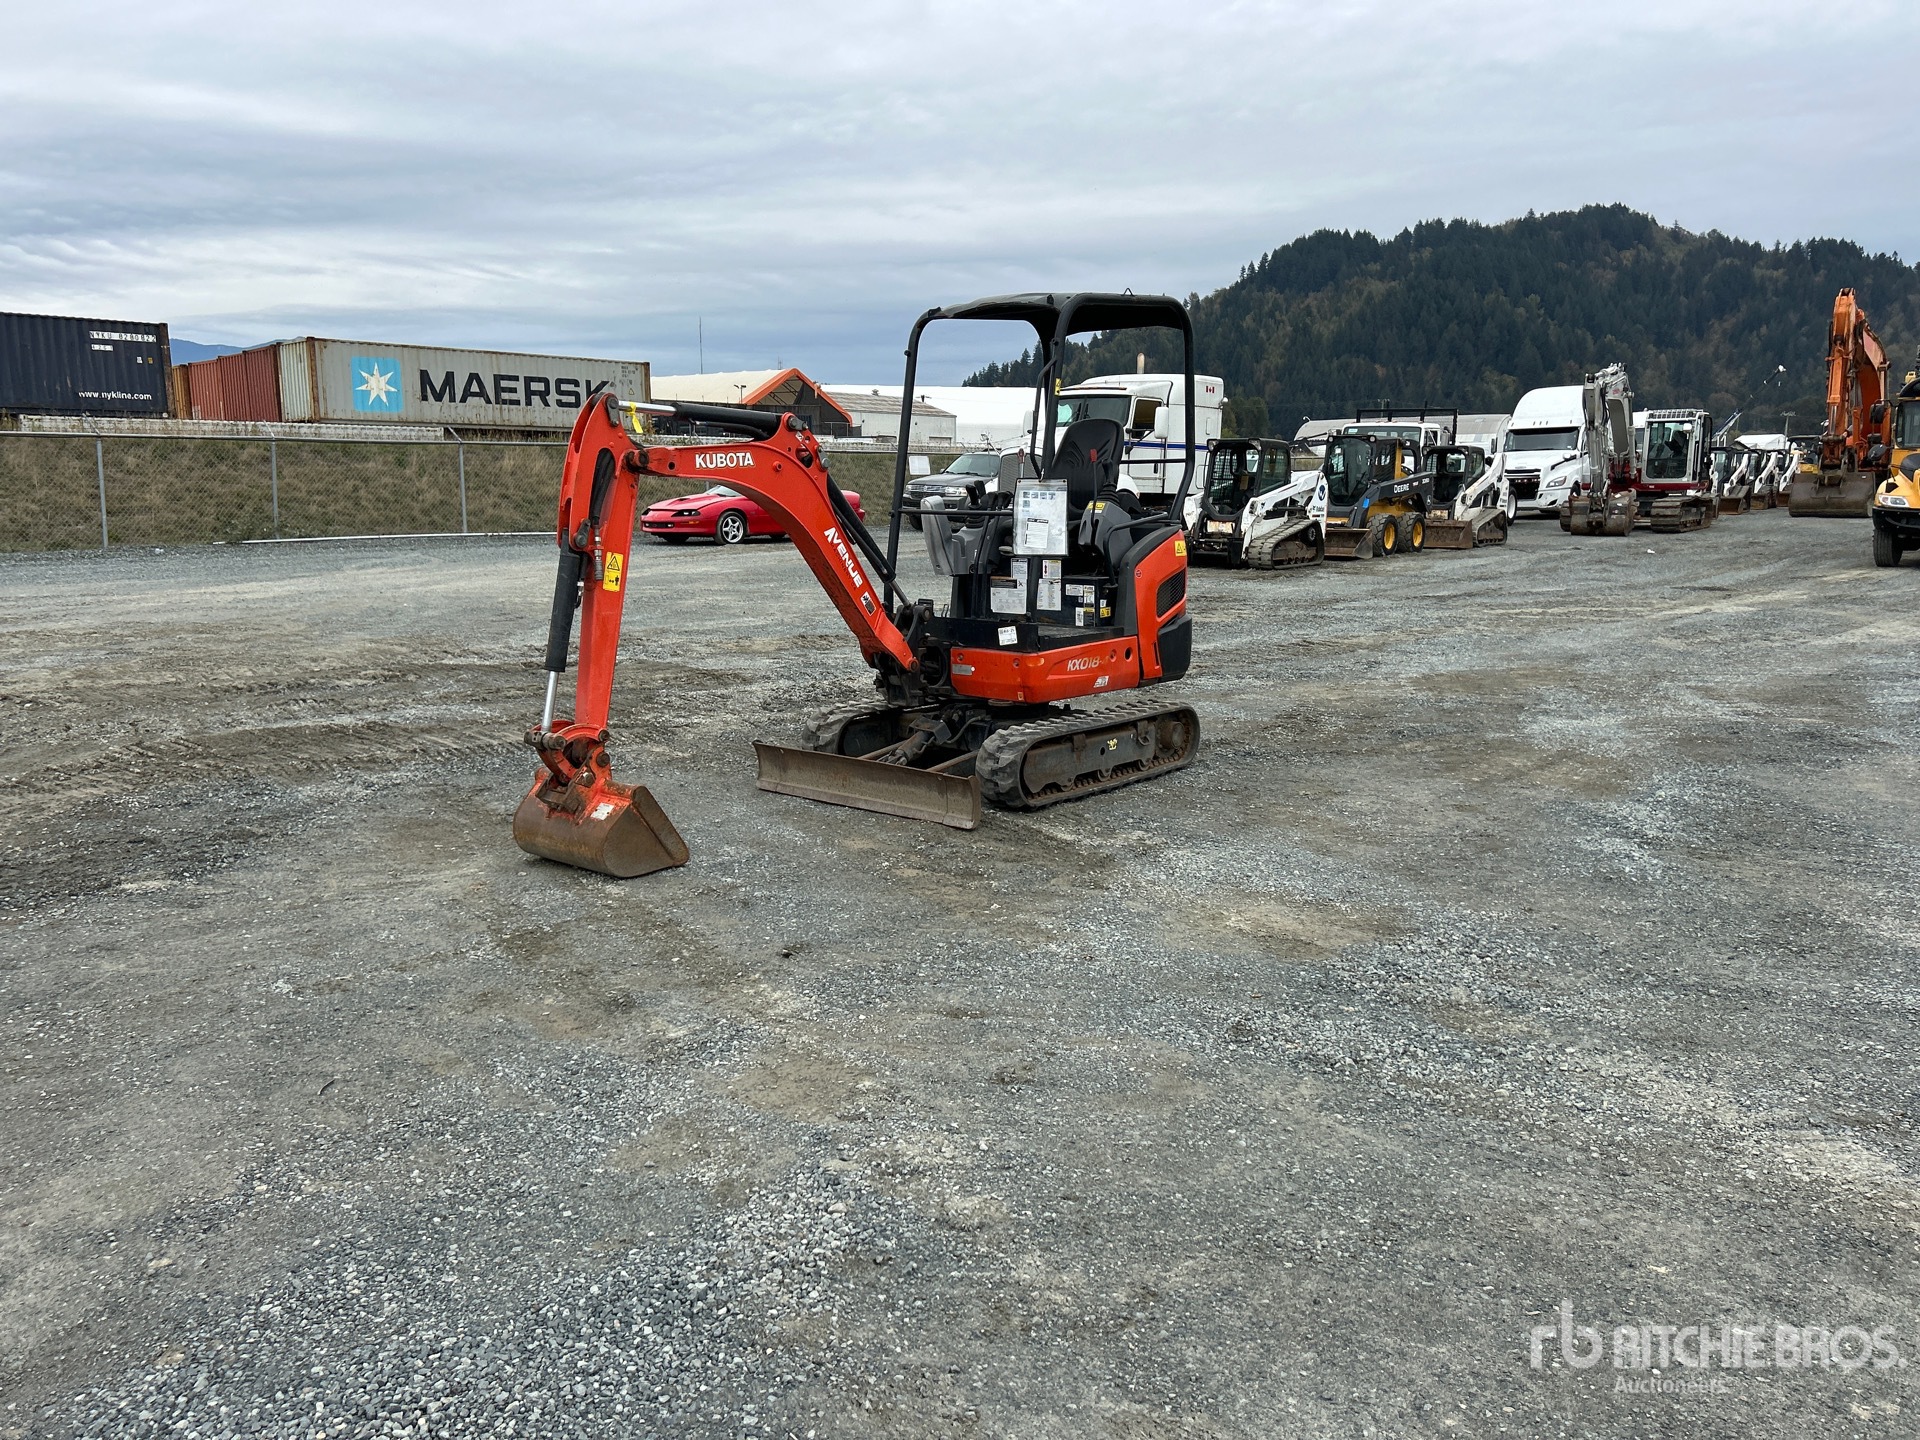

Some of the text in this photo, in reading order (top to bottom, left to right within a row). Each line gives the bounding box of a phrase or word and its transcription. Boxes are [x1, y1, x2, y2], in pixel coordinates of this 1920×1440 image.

[78, 391, 152, 401] www.nykline.com
[419, 369, 610, 408] MAERSK
[695, 452, 755, 469] KUBOTA
[1393, 483, 1410, 493] DEERE
[823, 527, 863, 588] AVENUE
